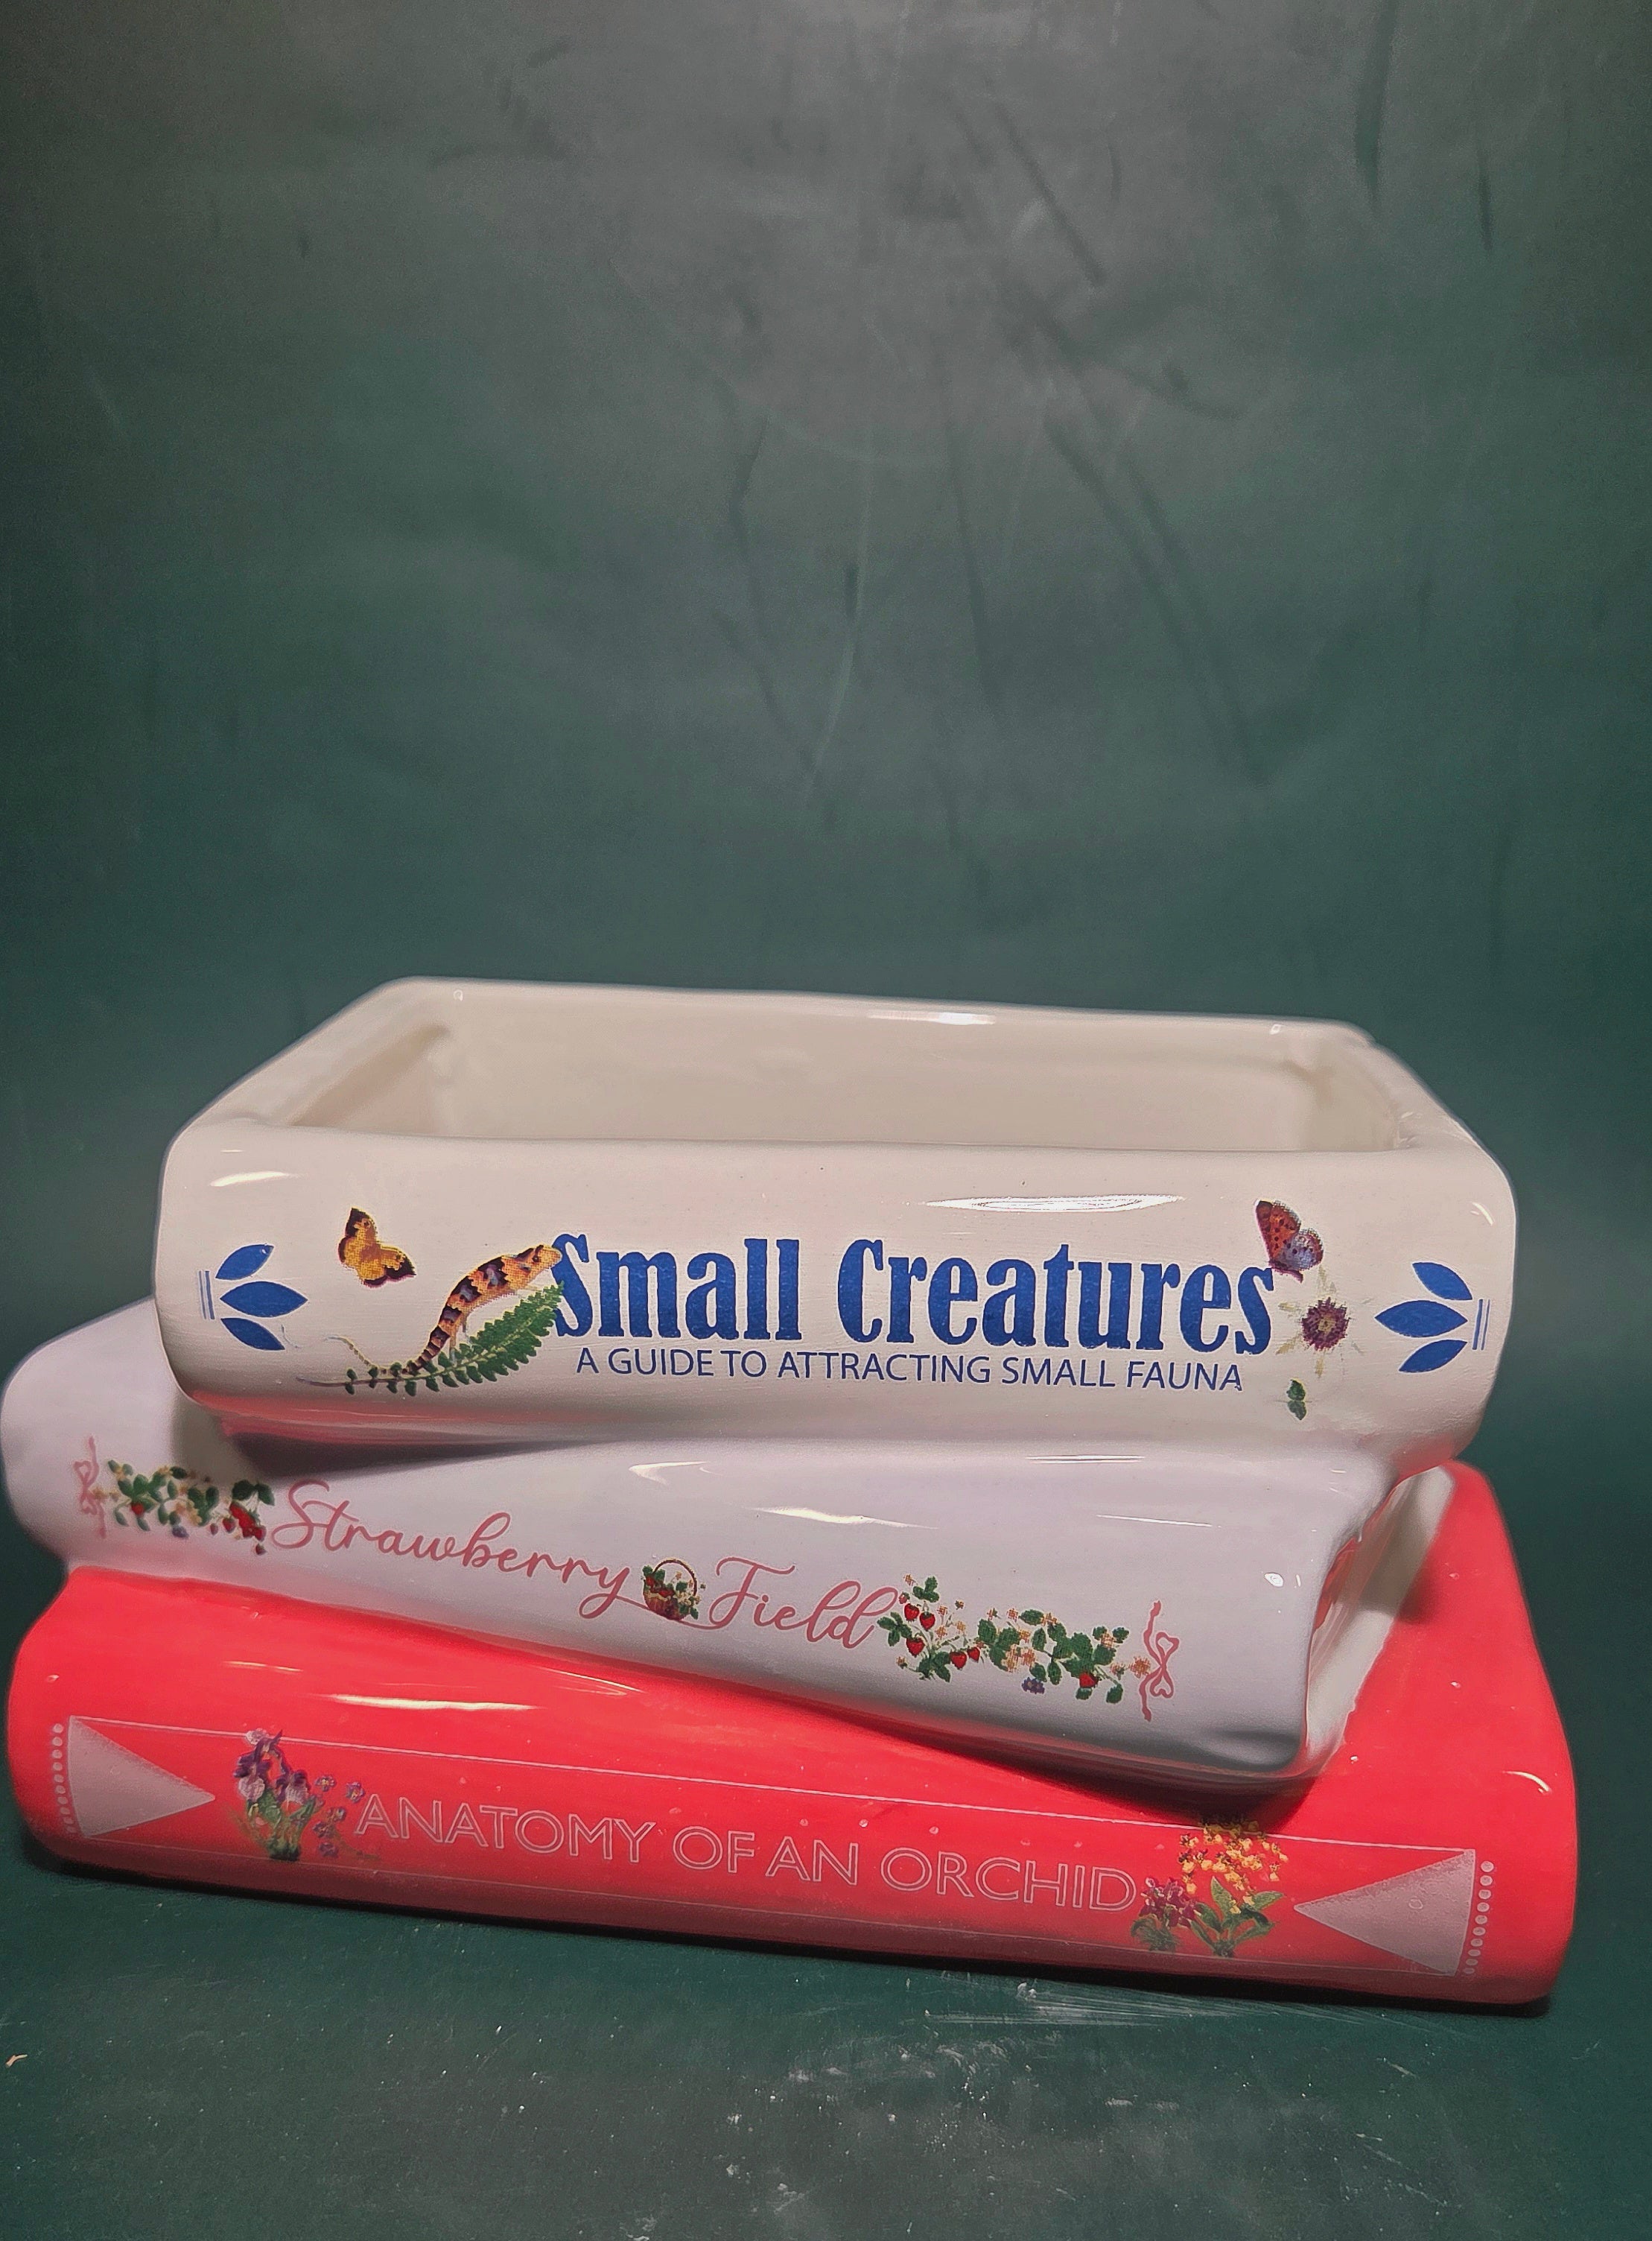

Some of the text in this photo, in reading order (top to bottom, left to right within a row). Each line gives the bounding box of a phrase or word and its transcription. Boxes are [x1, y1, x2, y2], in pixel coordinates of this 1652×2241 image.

[550, 1232, 1275, 1355] Small Creatures
[576, 1347, 1243, 1392] A GUIDE TO ATTRACTING SMALL FAUNA
[271, 1480, 899, 1650] Strawberry Field
[354, 1793, 1137, 1912] ANATOMY OF AN ORCHID
